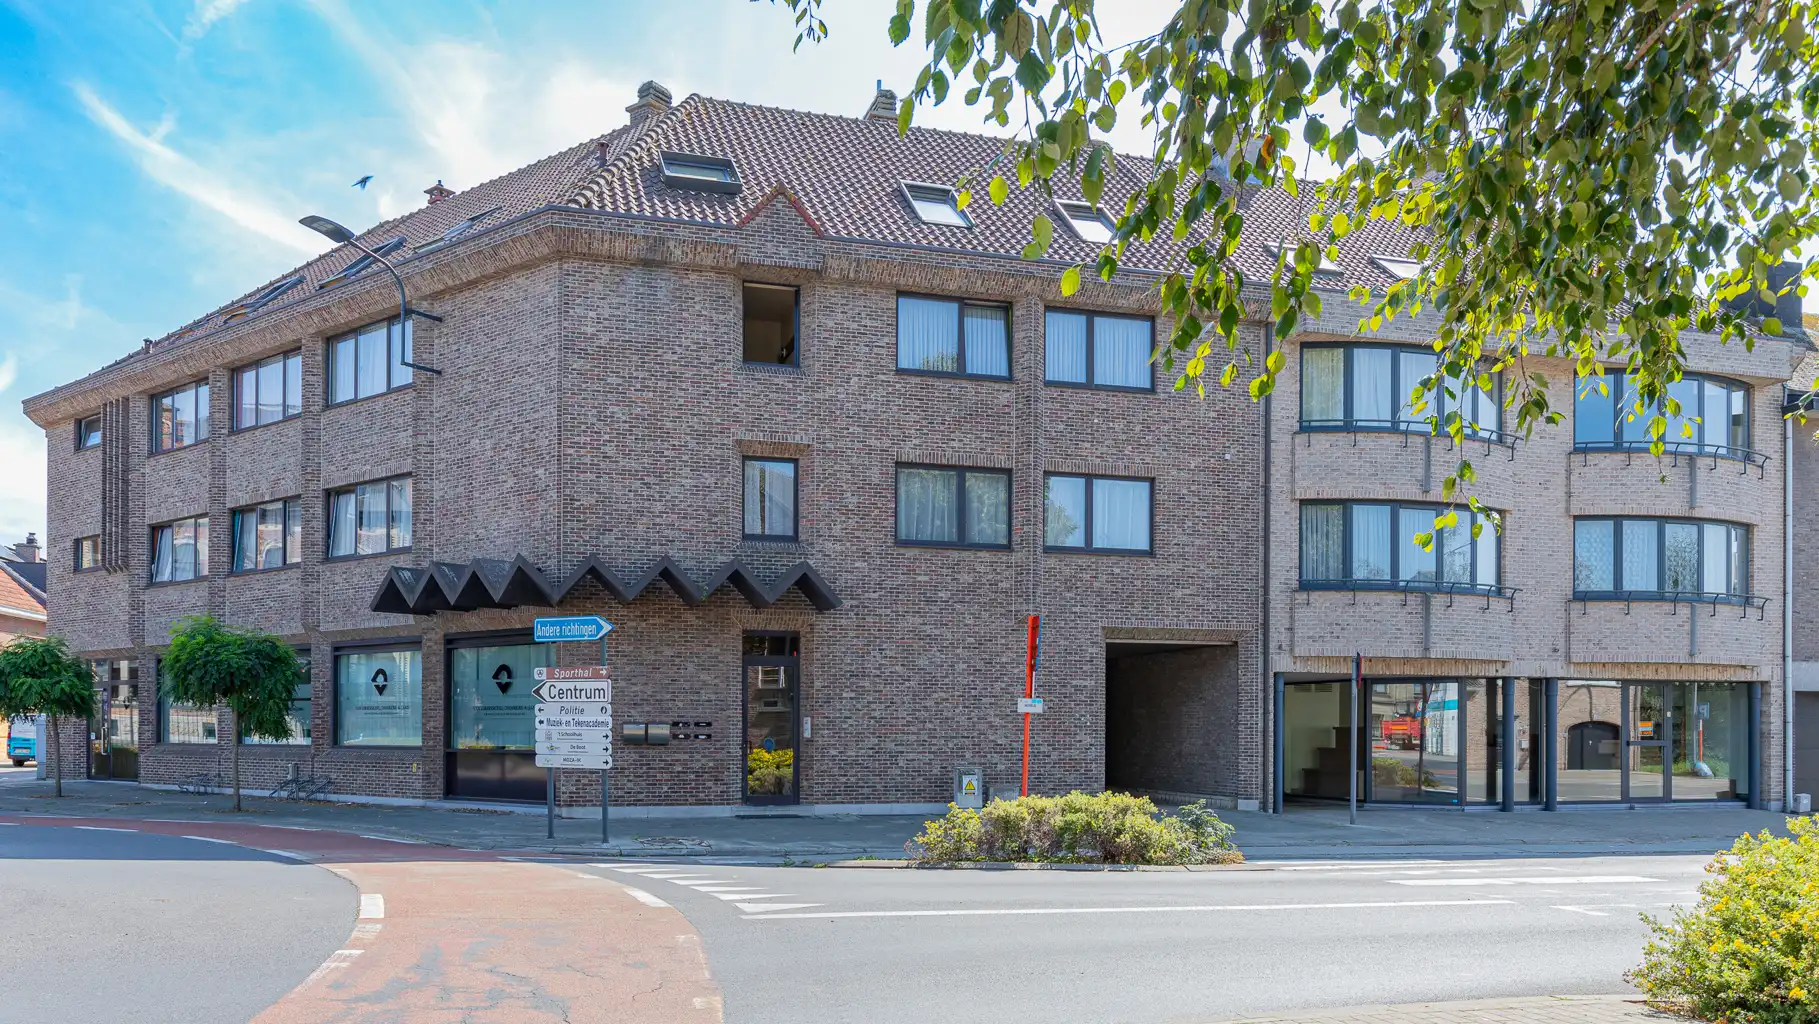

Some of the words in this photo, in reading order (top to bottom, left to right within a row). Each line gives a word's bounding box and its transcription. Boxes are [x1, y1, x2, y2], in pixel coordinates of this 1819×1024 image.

[536, 623, 560, 636] Andere
[562, 623, 597, 638] richtingen
[554, 667, 592, 679] Sporthal
[548, 683, 606, 700] Centrum
[559, 705, 585, 715] Politie
[546, 717, 564, 727] Muziek-
[564, 720, 571, 728] en
[572, 718, 610, 728] Tekenacademie
